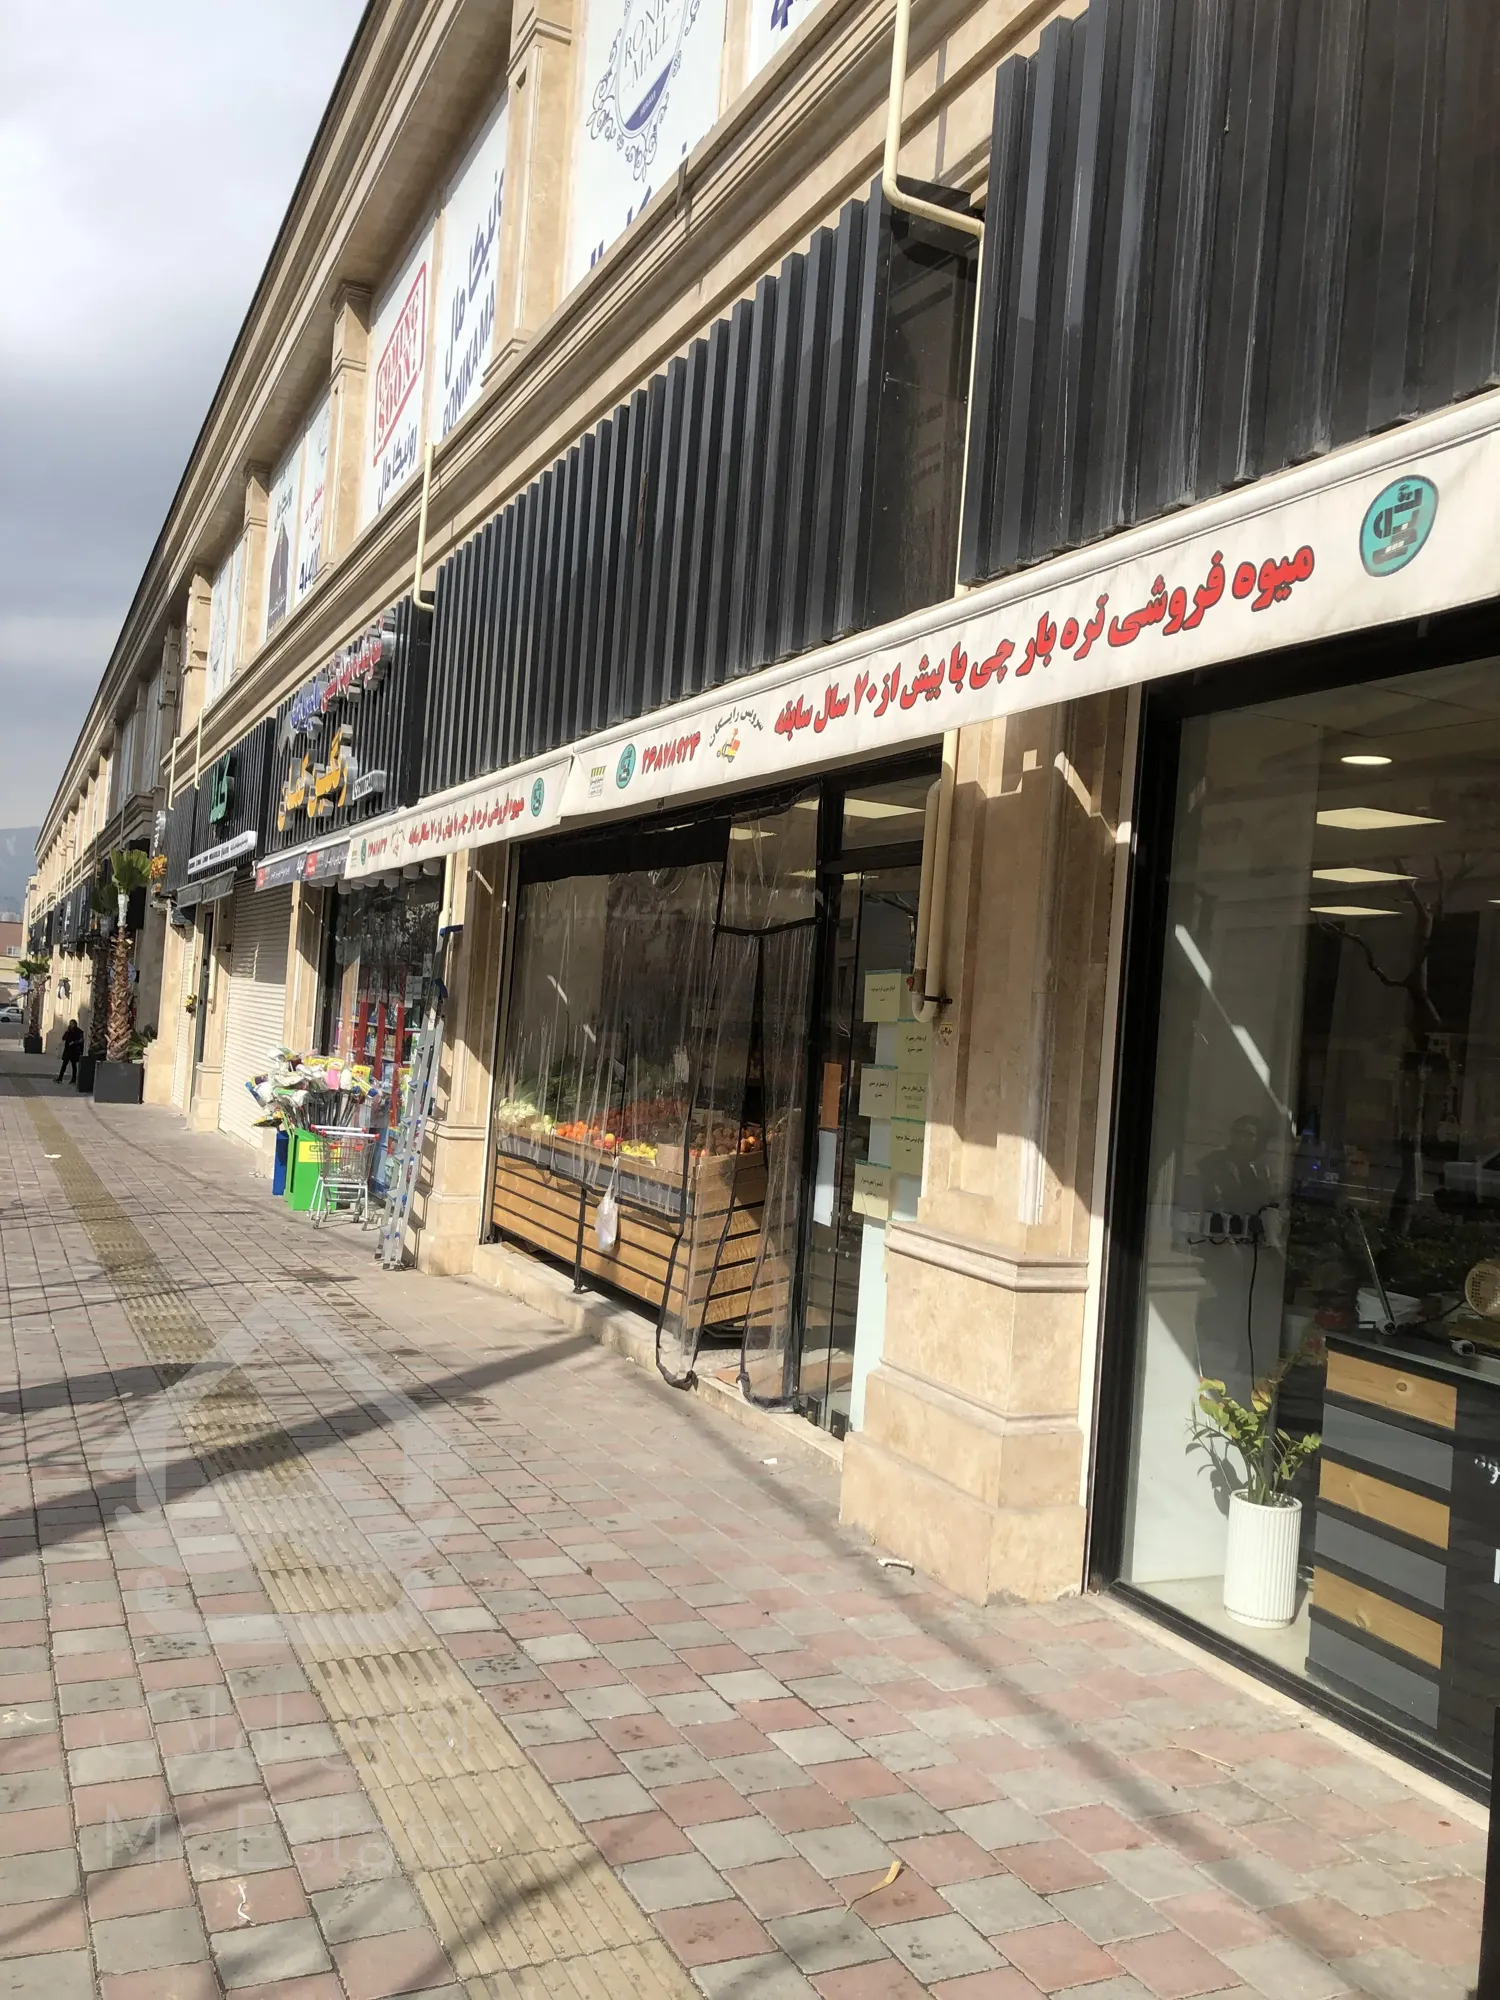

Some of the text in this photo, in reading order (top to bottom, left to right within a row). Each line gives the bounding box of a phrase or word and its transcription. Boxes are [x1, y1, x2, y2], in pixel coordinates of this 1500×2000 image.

[632, 16, 669, 89] MALL
[378, 289, 420, 402] COMING
[377, 334, 418, 442] SOON!
[1107, 550, 1226, 647] فروشی
[1232, 545, 1315, 612] میوه
[1015, 611, 1057, 677] بار
[1060, 593, 1109, 661] تره
[874, 662, 902, 718] از
[900, 654, 946, 710] بیش
[948, 641, 968, 694] با
[969, 638, 1016, 690] چی
[708, 706, 764, 748] سرویس رایگان
[774, 694, 813, 741] سابقه
[813, 683, 850, 734] سال
